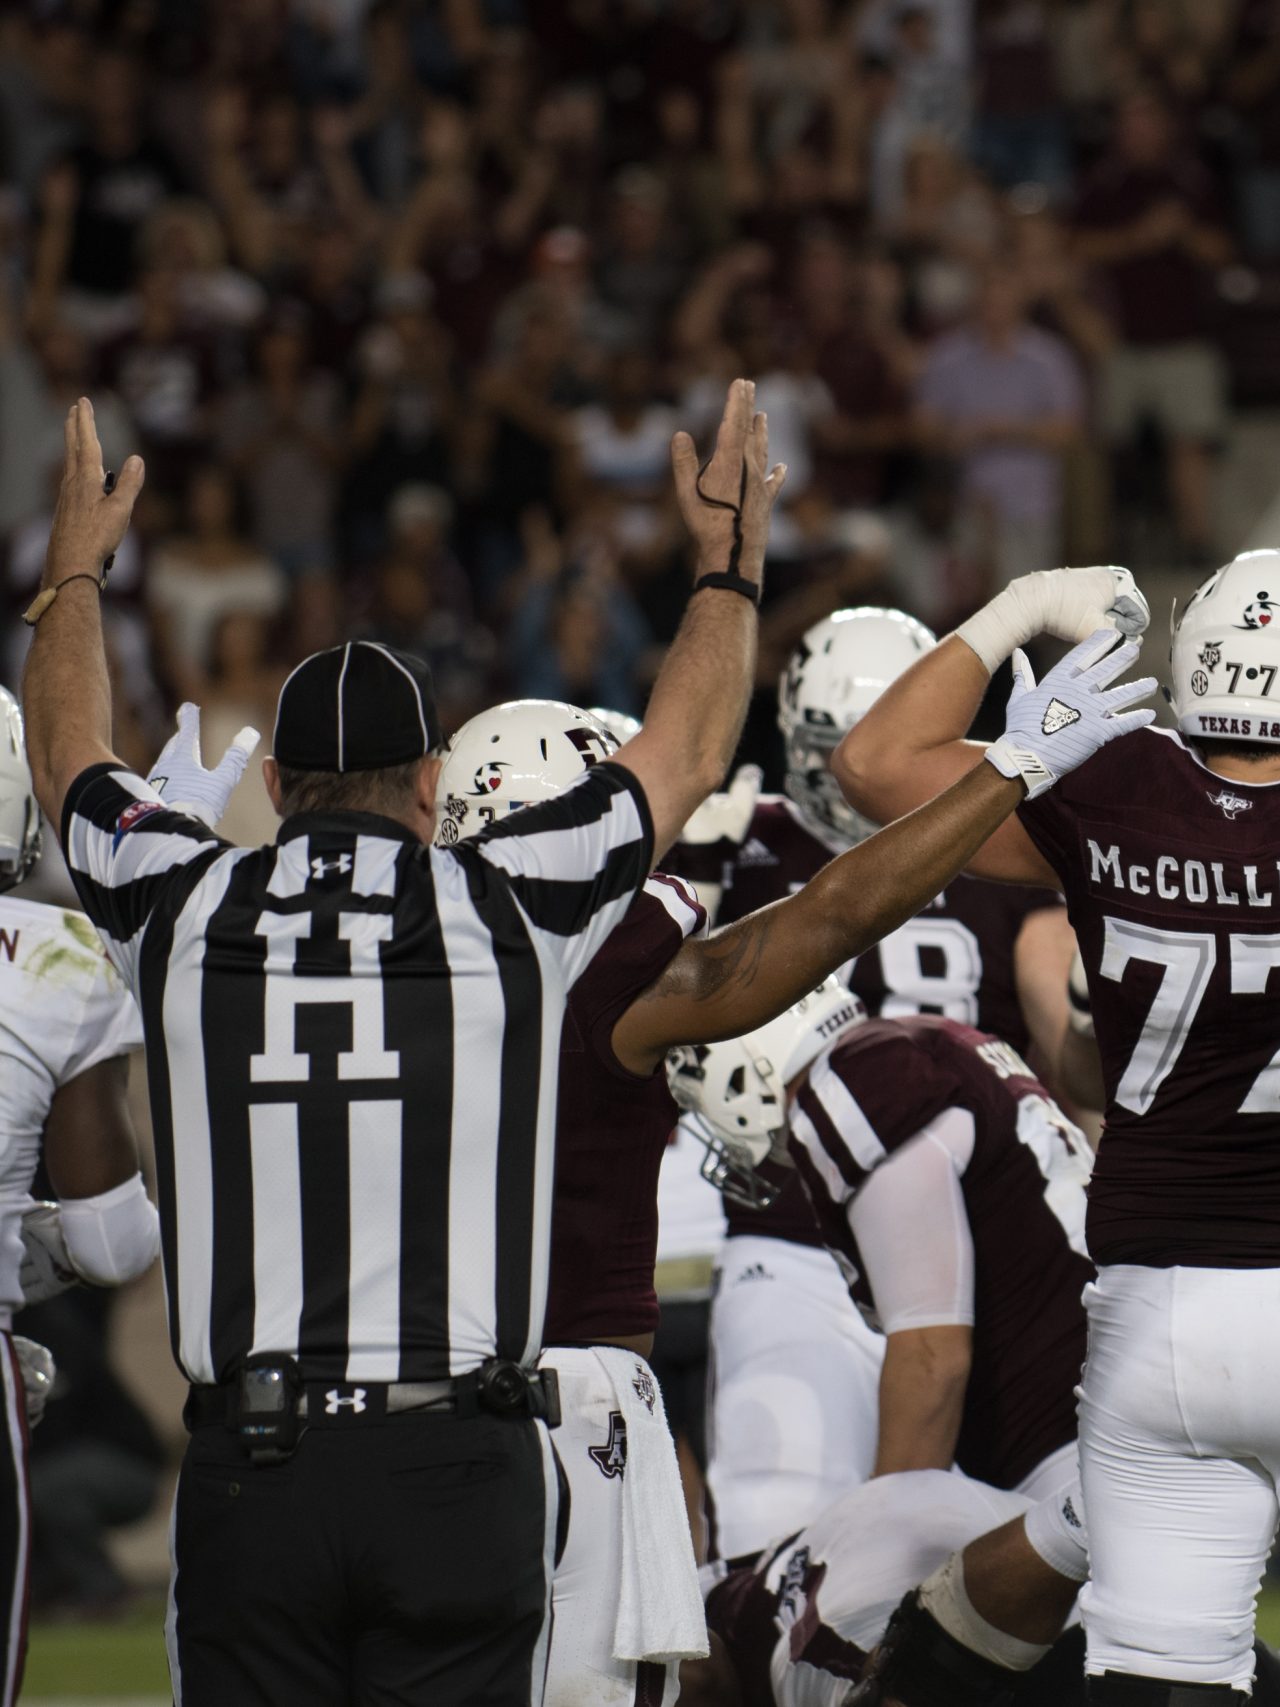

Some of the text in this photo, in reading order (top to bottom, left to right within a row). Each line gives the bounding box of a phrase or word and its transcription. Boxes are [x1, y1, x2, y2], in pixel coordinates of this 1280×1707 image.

[1199, 716, 1251, 735] TEXAS
[250, 910, 400, 1083] H
[838, 917, 983, 1028] 8
